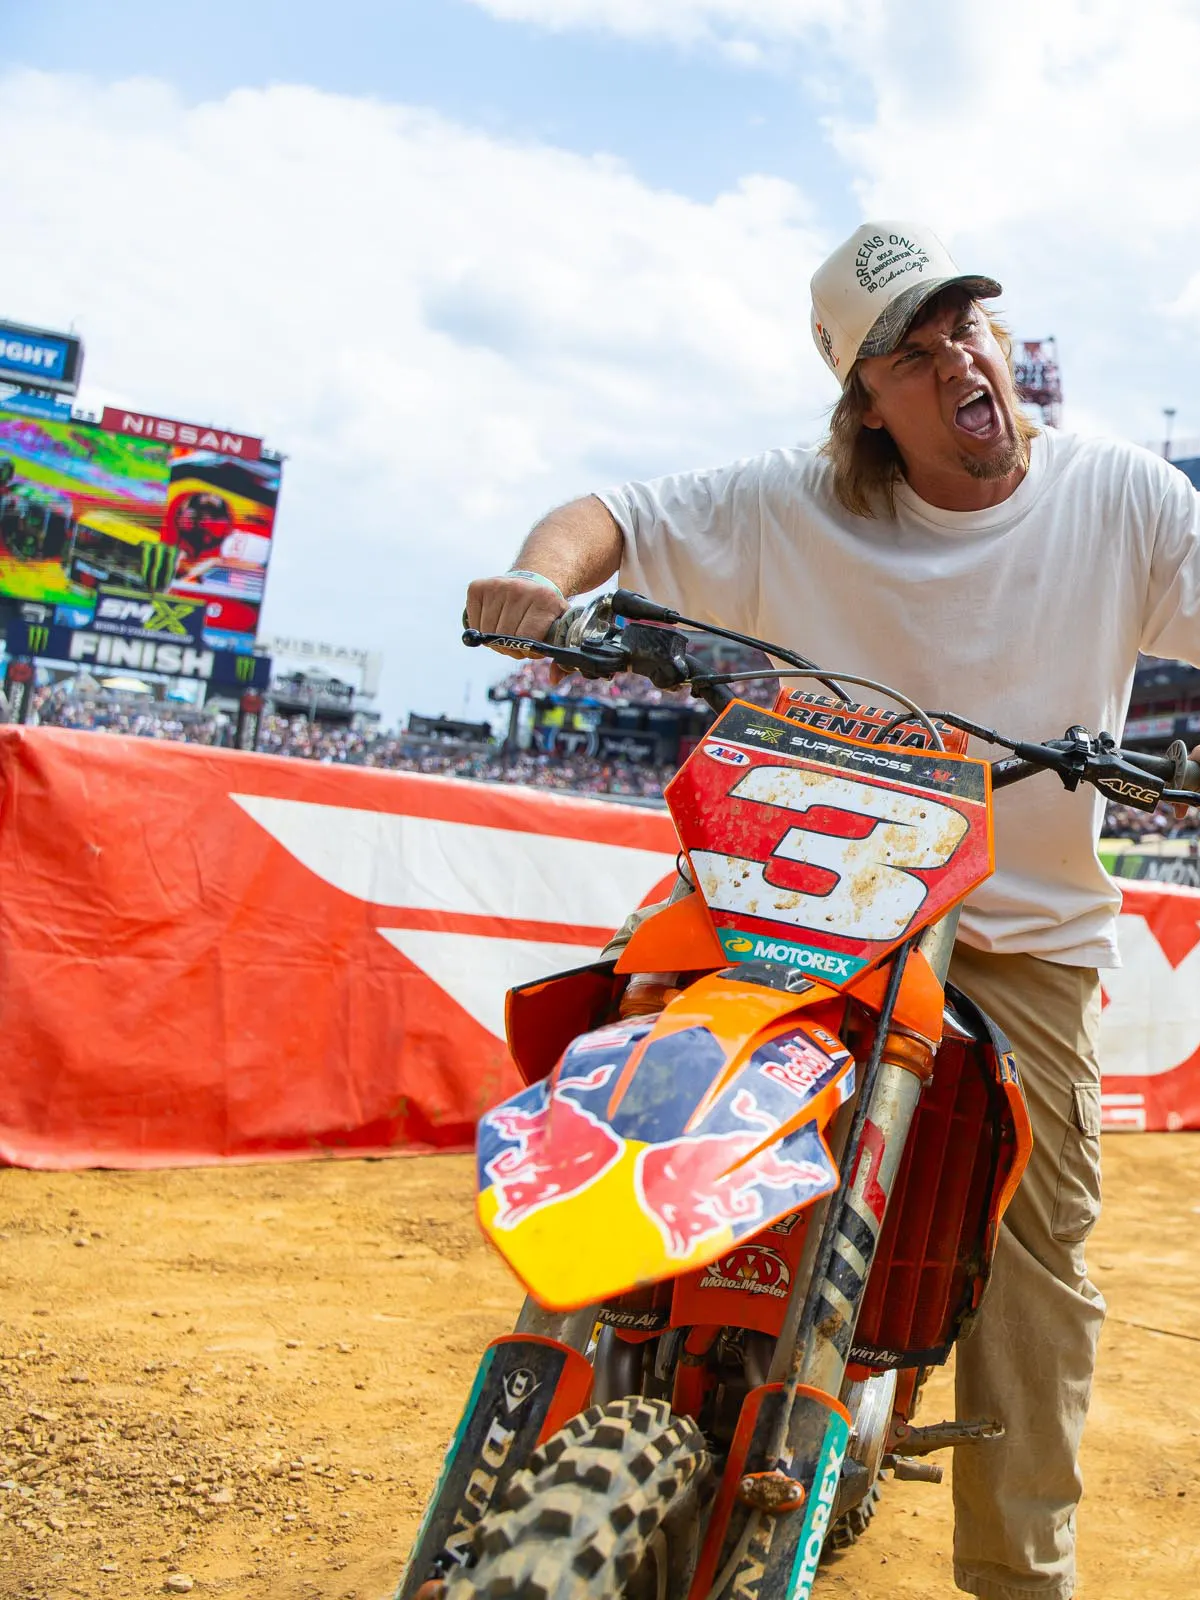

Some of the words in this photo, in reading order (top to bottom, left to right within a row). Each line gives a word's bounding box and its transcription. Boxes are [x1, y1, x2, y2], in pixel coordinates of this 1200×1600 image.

[856, 235, 884, 287] GREENS
[889, 234, 926, 255] ONLY
[871, 250, 911, 276] ASSOCIATION
[121, 413, 244, 455] NISSAN
[68, 630, 214, 679] FINISH
[710, 748, 747, 764] AMA
[744, 724, 786, 744] SMX
[790, 736, 912, 773] SUPERCROSS
[1098, 778, 1160, 804] ARC
[686, 766, 970, 942] 3
[754, 939, 850, 977] MOTOREX
[701, 1276, 788, 1299] Moto-Master
[598, 1308, 635, 1324] Twin
[634, 1313, 659, 1326] Air
[847, 1345, 875, 1360] win
[874, 1350, 901, 1363] Air
